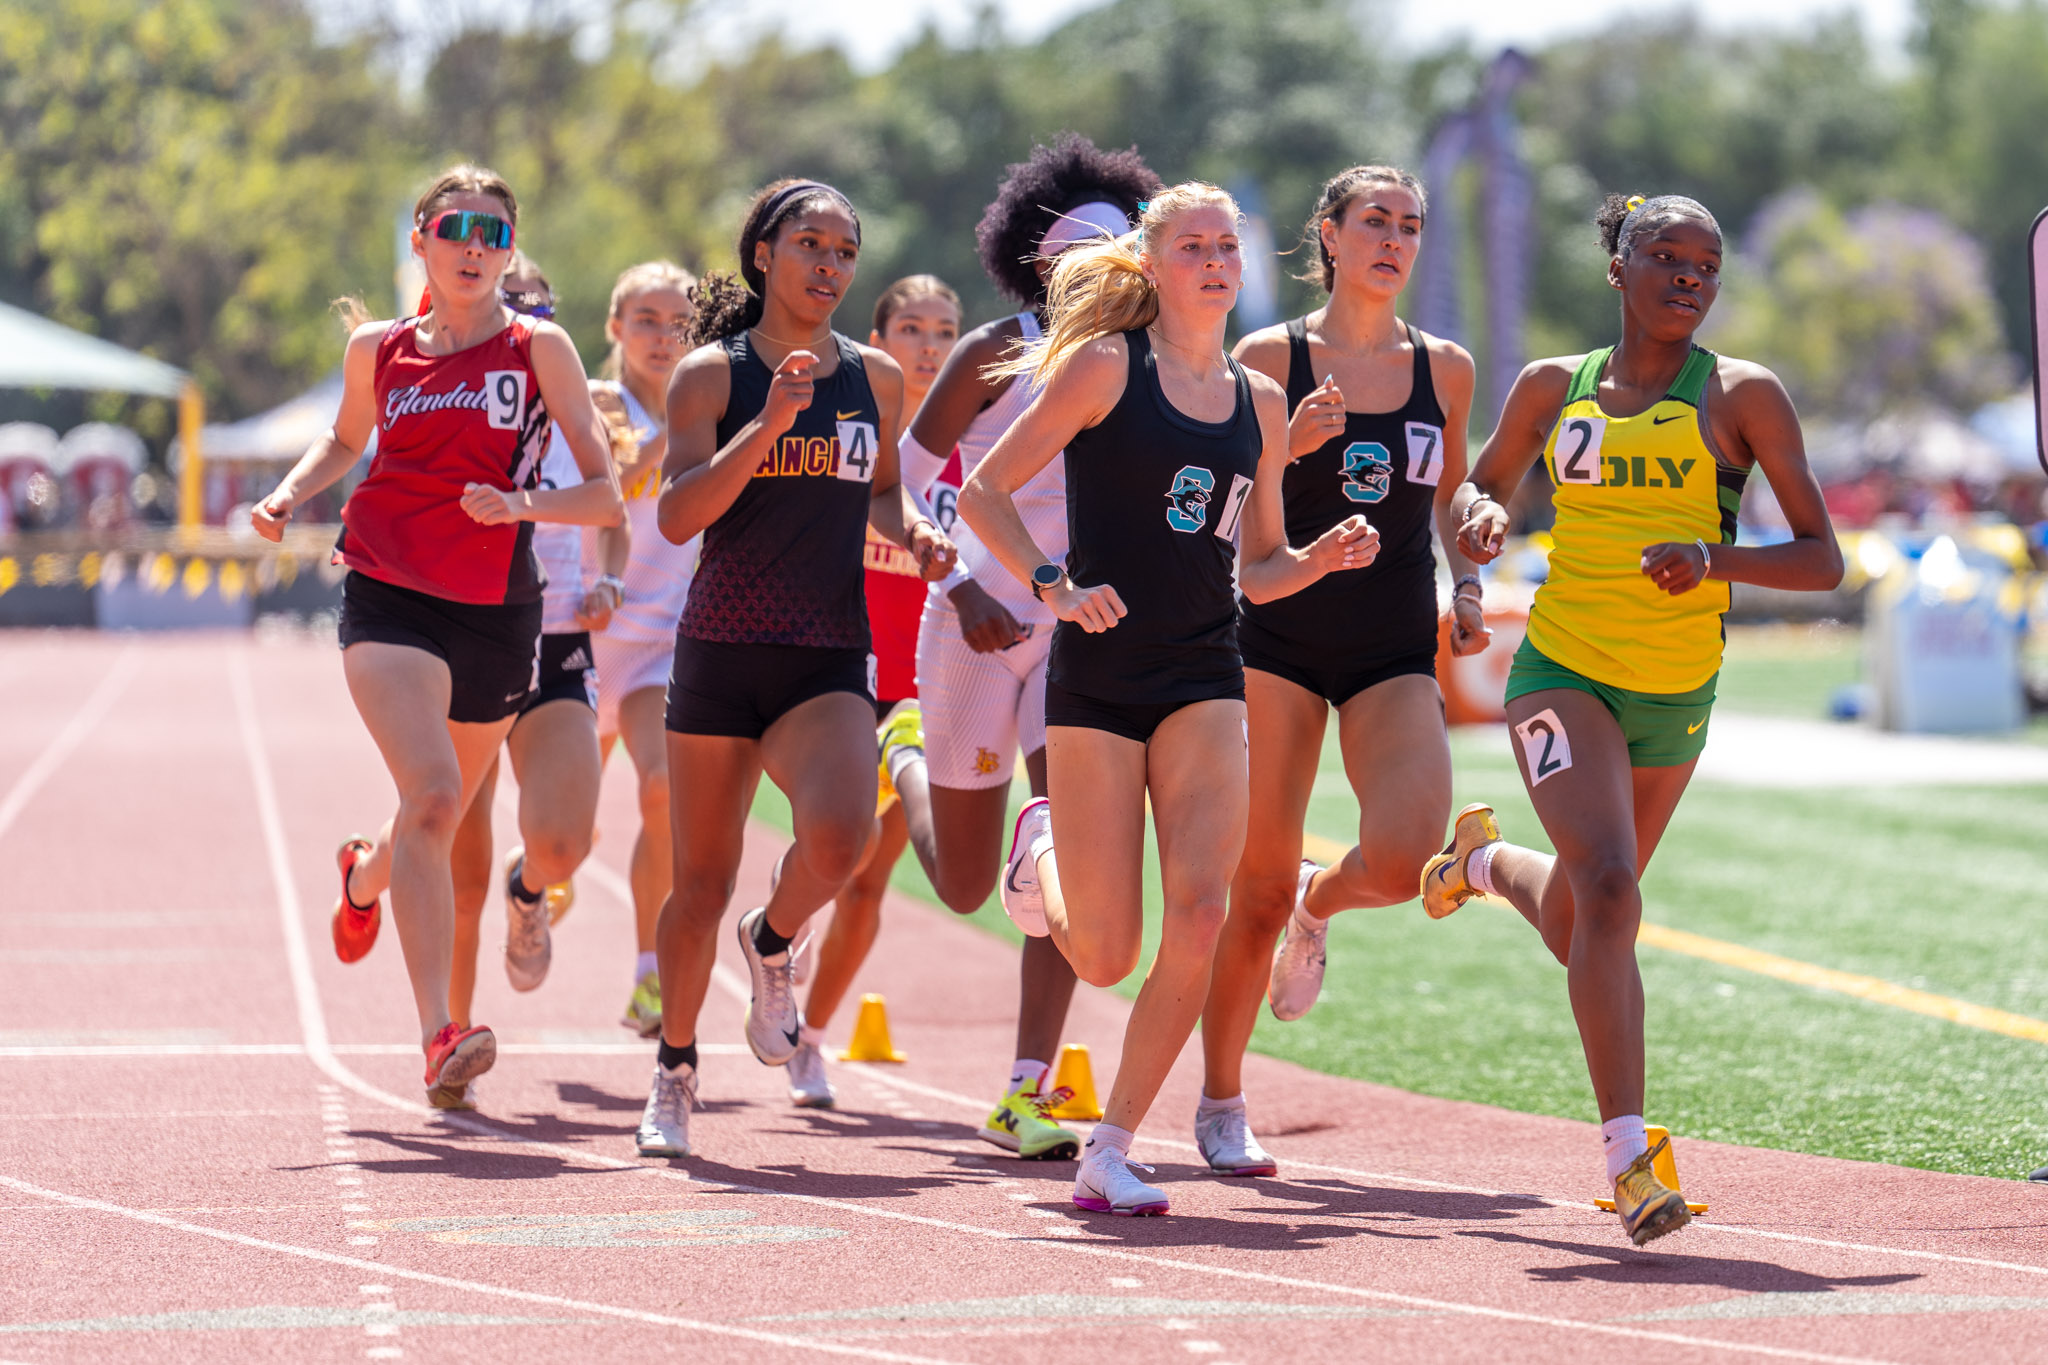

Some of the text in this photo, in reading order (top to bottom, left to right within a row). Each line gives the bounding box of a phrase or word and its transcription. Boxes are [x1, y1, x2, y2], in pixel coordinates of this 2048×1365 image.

[496, 373, 519, 425] 9
[846, 426, 869, 478] 4
[1410, 426, 1437, 479] 7
[1551, 455, 1697, 489] OLY
[1563, 419, 1593, 481] 2
[936, 489, 957, 533] 6
[1226, 482, 1250, 537] 1
[1527, 719, 1562, 779] 2
